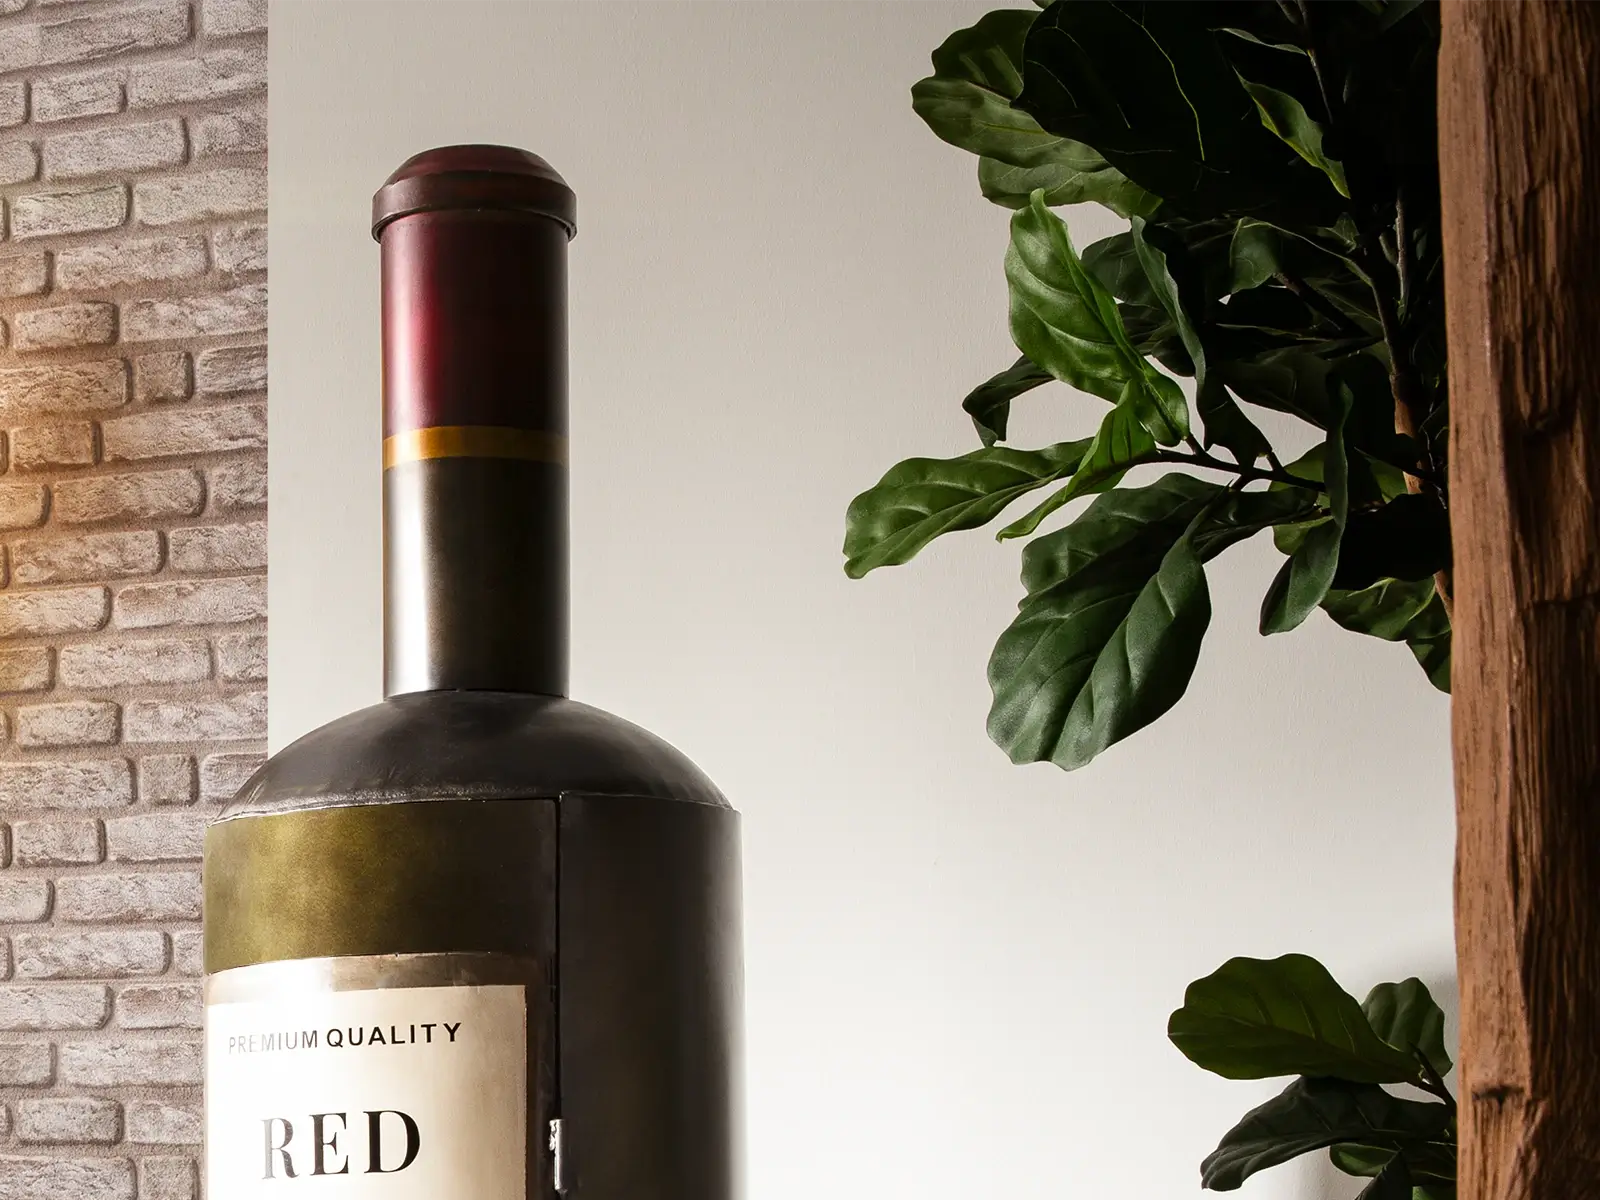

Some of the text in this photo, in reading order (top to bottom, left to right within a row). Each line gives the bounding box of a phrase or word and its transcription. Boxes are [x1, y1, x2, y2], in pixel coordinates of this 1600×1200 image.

[228, 1022, 463, 1054] PREMIUM QUALITY
[261, 1110, 421, 1180] RED
